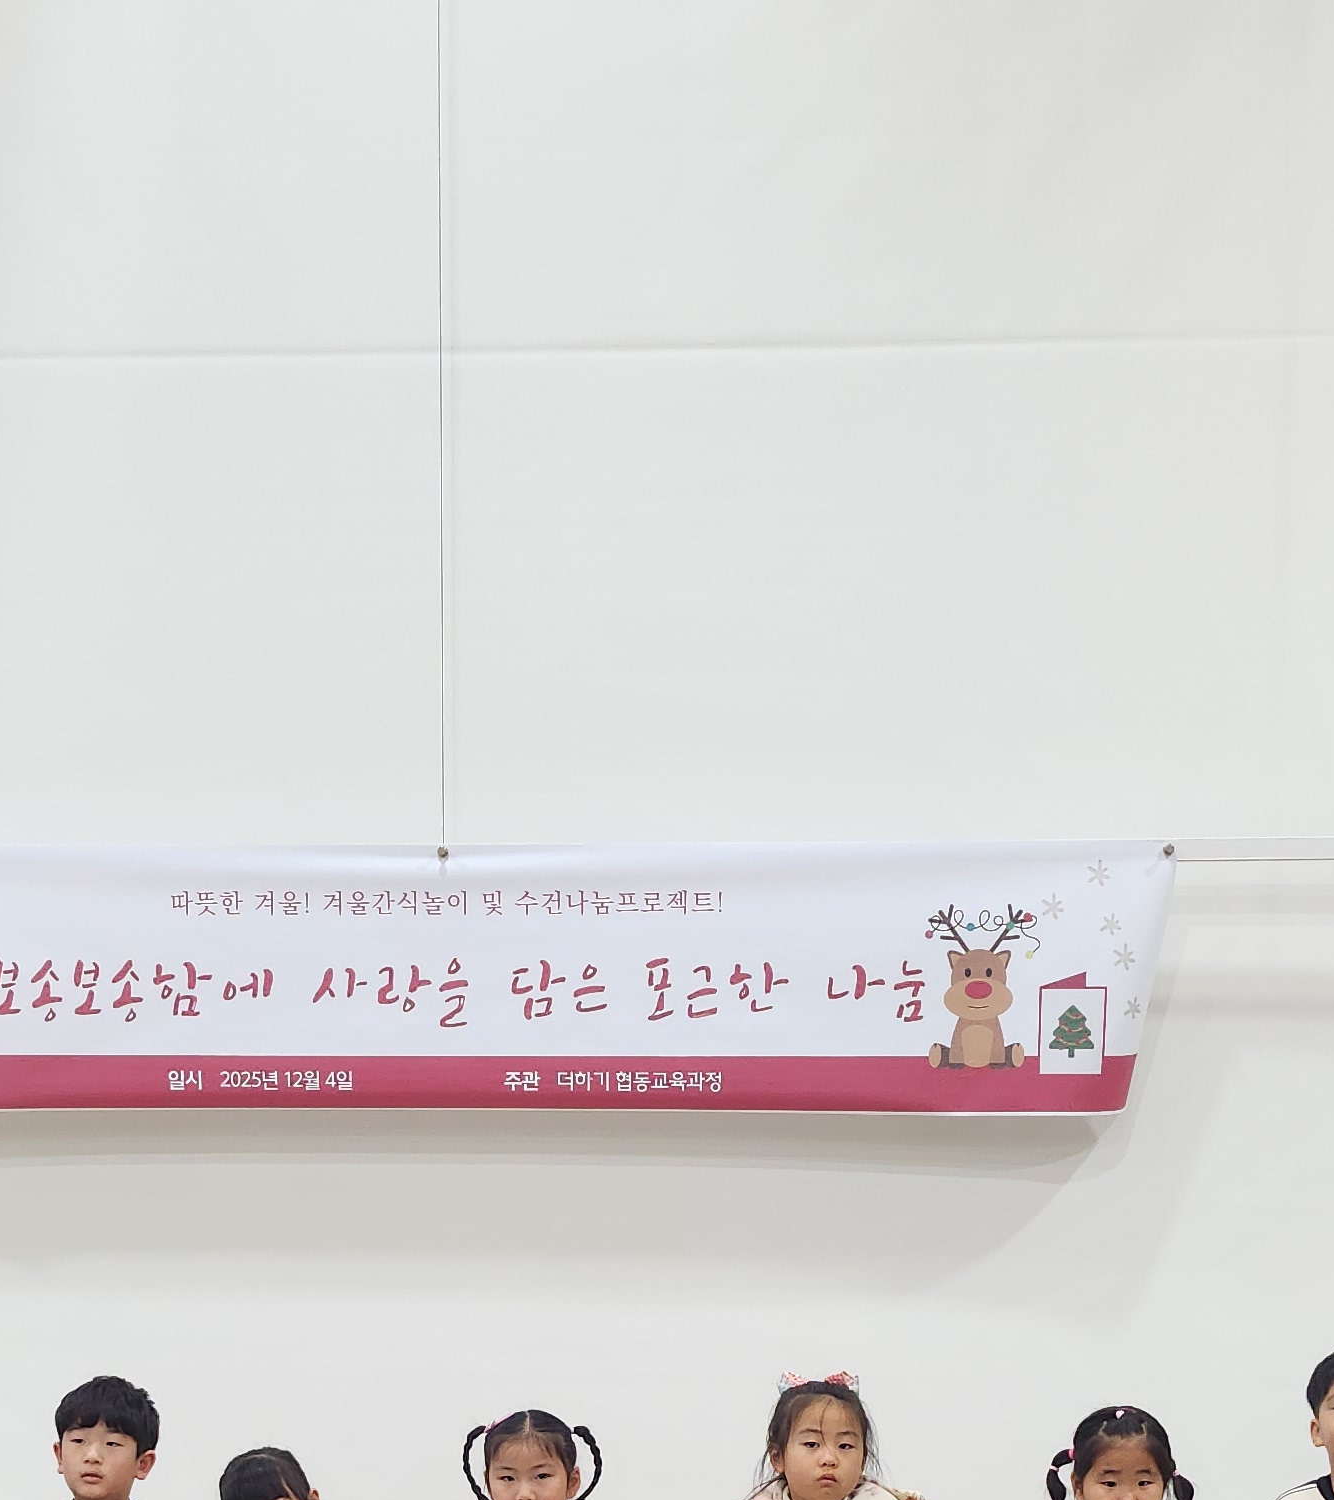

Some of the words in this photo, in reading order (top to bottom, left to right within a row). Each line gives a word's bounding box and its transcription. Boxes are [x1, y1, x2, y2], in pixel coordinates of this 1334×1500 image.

[170, 890, 244, 917] 따뜻한
[254, 890, 310, 917] 겨울!
[322, 889, 467, 917] 겨울간식놀이
[482, 890, 503, 916] 및
[514, 889, 724, 916] 수건나눔프로젝트!
[312, 957, 469, 1028] 사랑을
[510, 959, 608, 1021] 담은
[645, 957, 790, 1022] 포근한
[827, 959, 926, 1023] 나눔
[168, 1069, 203, 1091] 일시
[219, 1070, 279, 1091] 2025년
[284, 1070, 321, 1091] 12월
[324, 1070, 354, 1091] 4일
[503, 1070, 542, 1092] 주관
[557, 1070, 610, 1092] 더하기
[615, 1070, 722, 1093] 협동교육과정
